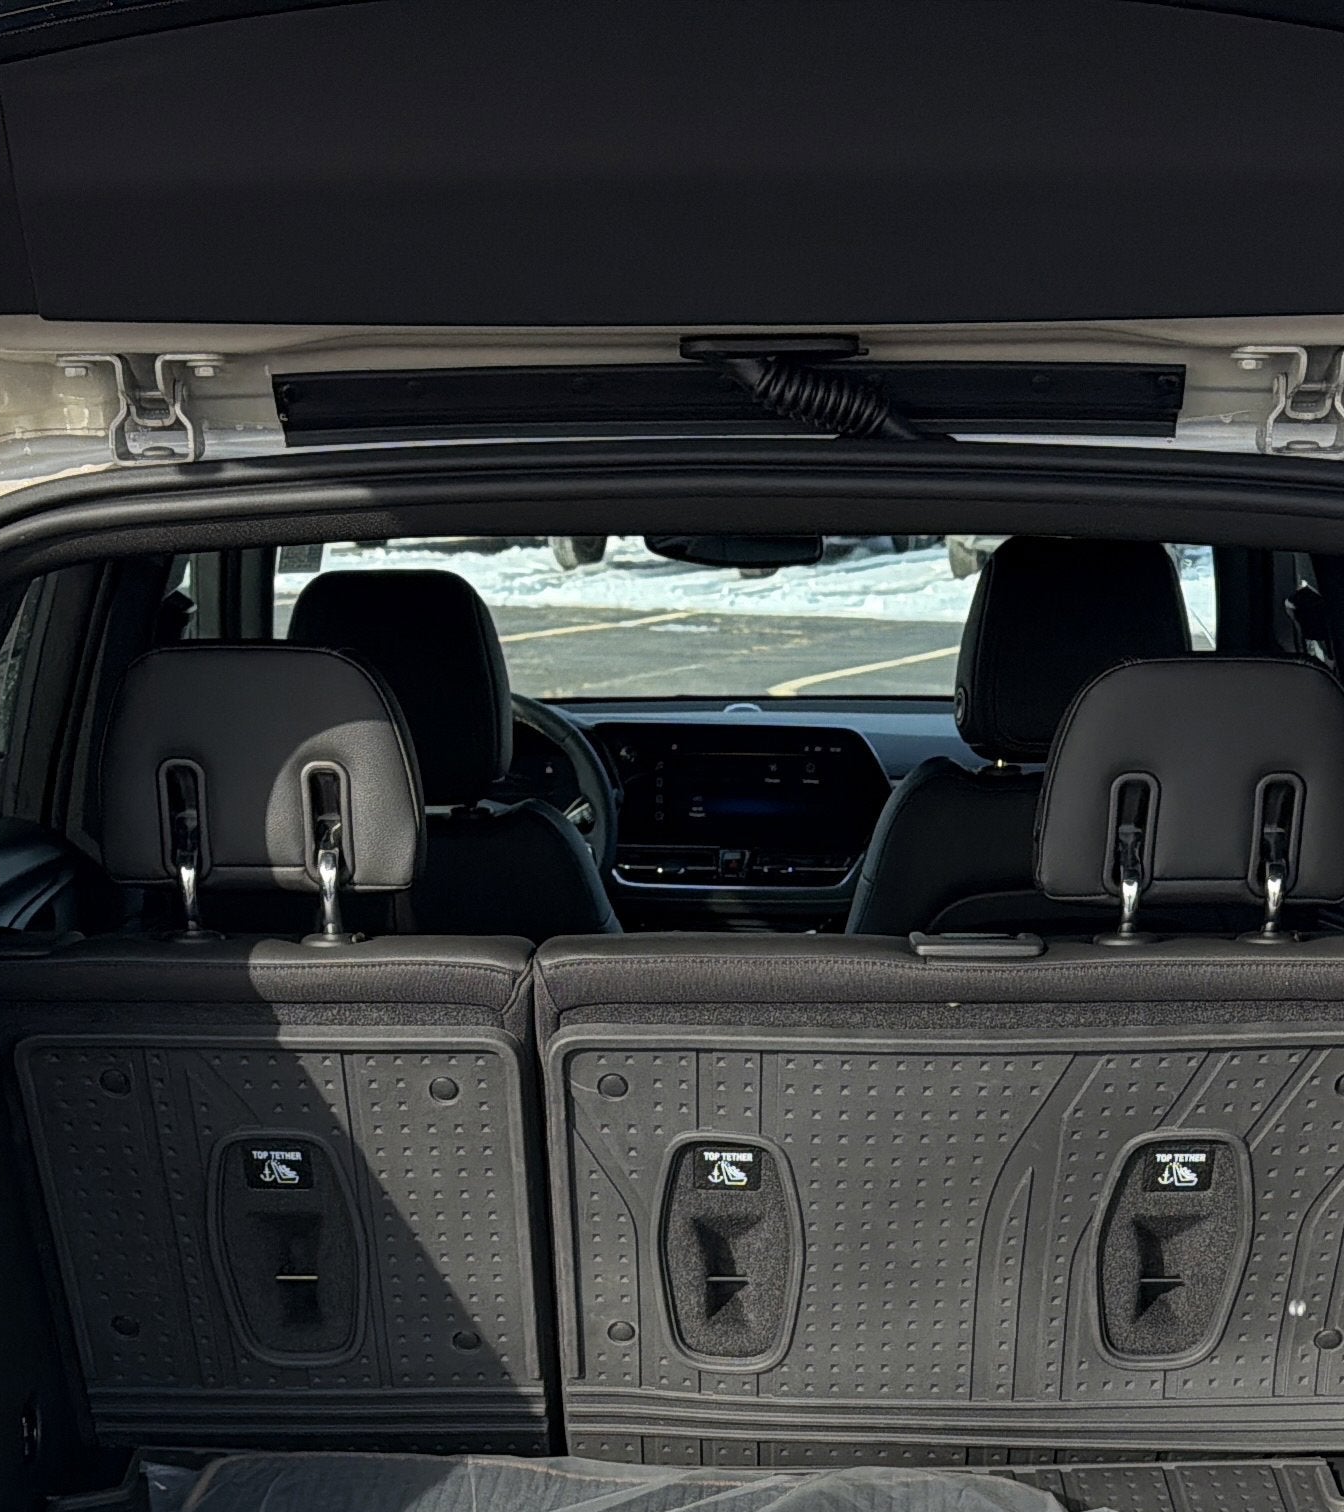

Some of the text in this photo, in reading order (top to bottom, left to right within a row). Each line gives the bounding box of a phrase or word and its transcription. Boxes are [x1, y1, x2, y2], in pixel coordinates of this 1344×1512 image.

[251, 1150, 302, 1161] TOP TETHER
[703, 1151, 753, 1162] TOP TETHER
[1155, 1153, 1207, 1163] TOP TETHER
